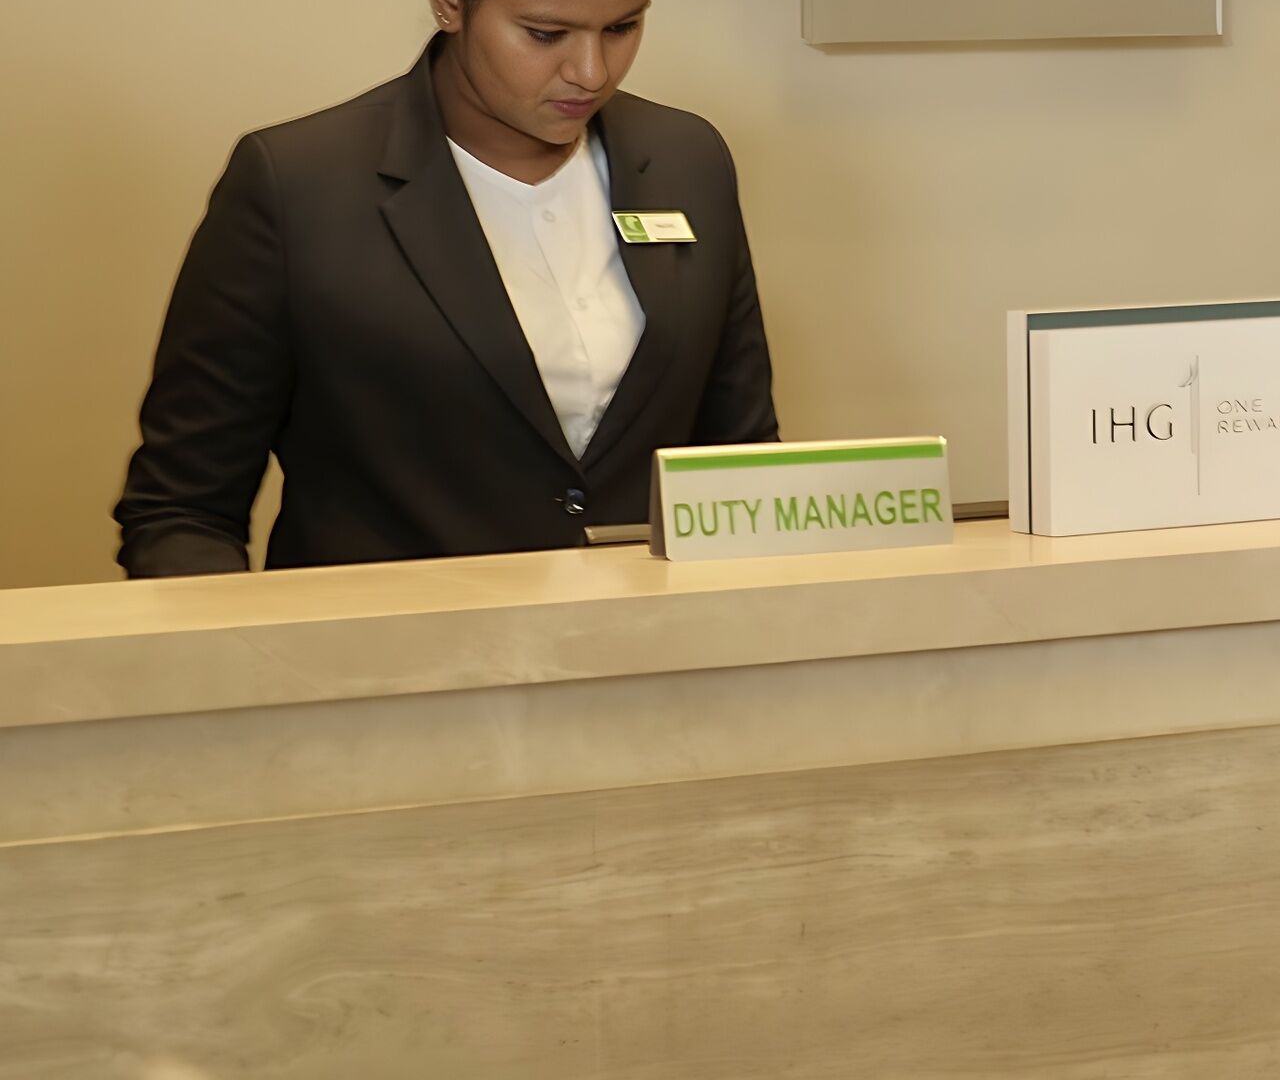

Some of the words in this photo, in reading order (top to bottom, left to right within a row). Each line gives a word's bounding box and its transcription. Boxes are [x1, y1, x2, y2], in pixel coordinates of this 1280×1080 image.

[1091, 403, 1174, 444] IHG
[1216, 398, 1264, 415] ONE
[672, 498, 763, 538] DUTY
[773, 488, 944, 532] MANAGER
